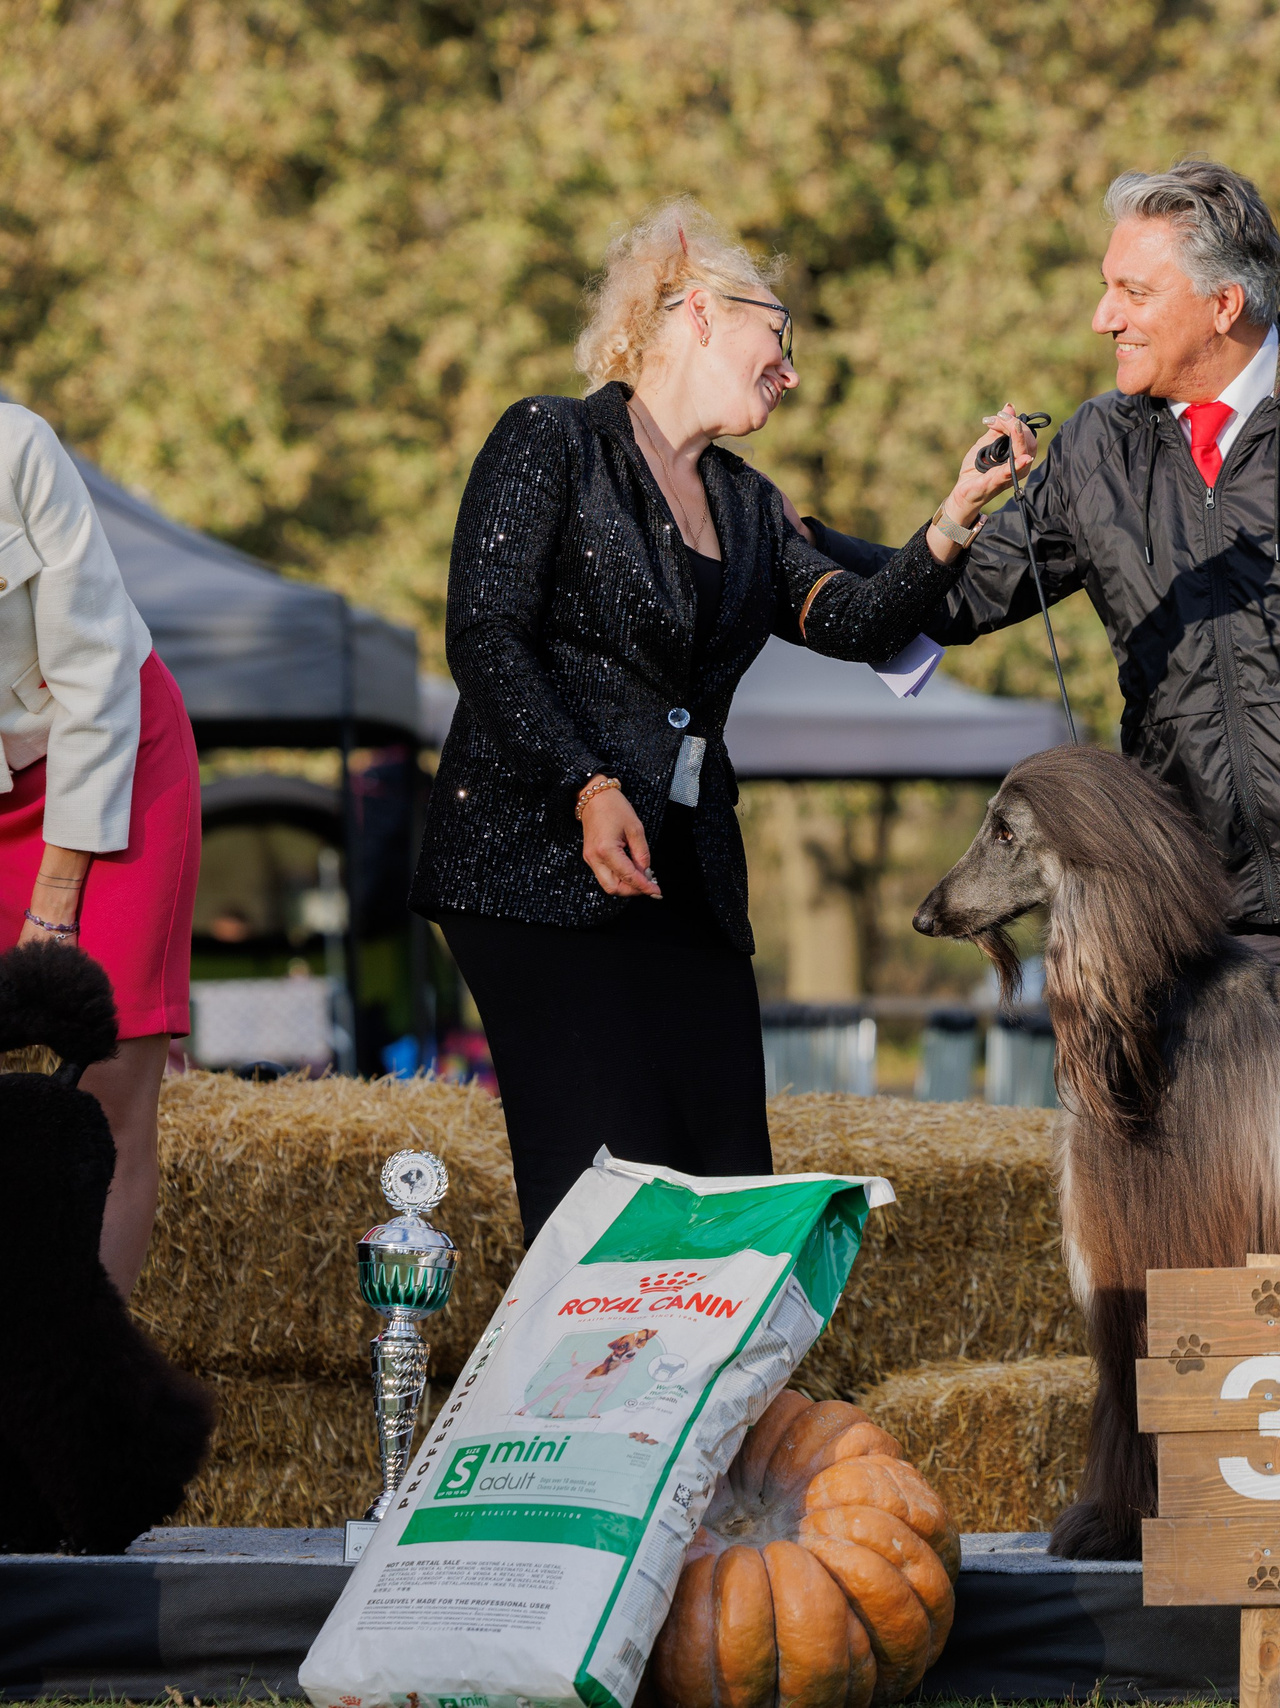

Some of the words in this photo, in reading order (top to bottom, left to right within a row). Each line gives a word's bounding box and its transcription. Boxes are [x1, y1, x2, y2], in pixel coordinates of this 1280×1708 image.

[558, 1296, 643, 1316] ROYAL
[648, 1292, 743, 1318] CANIN
[490, 1435, 572, 1464] mini
[446, 1455, 479, 1489] S
[480, 1472, 536, 1491] adult
[471, 1599, 527, 1608] PROFESSIONAL
